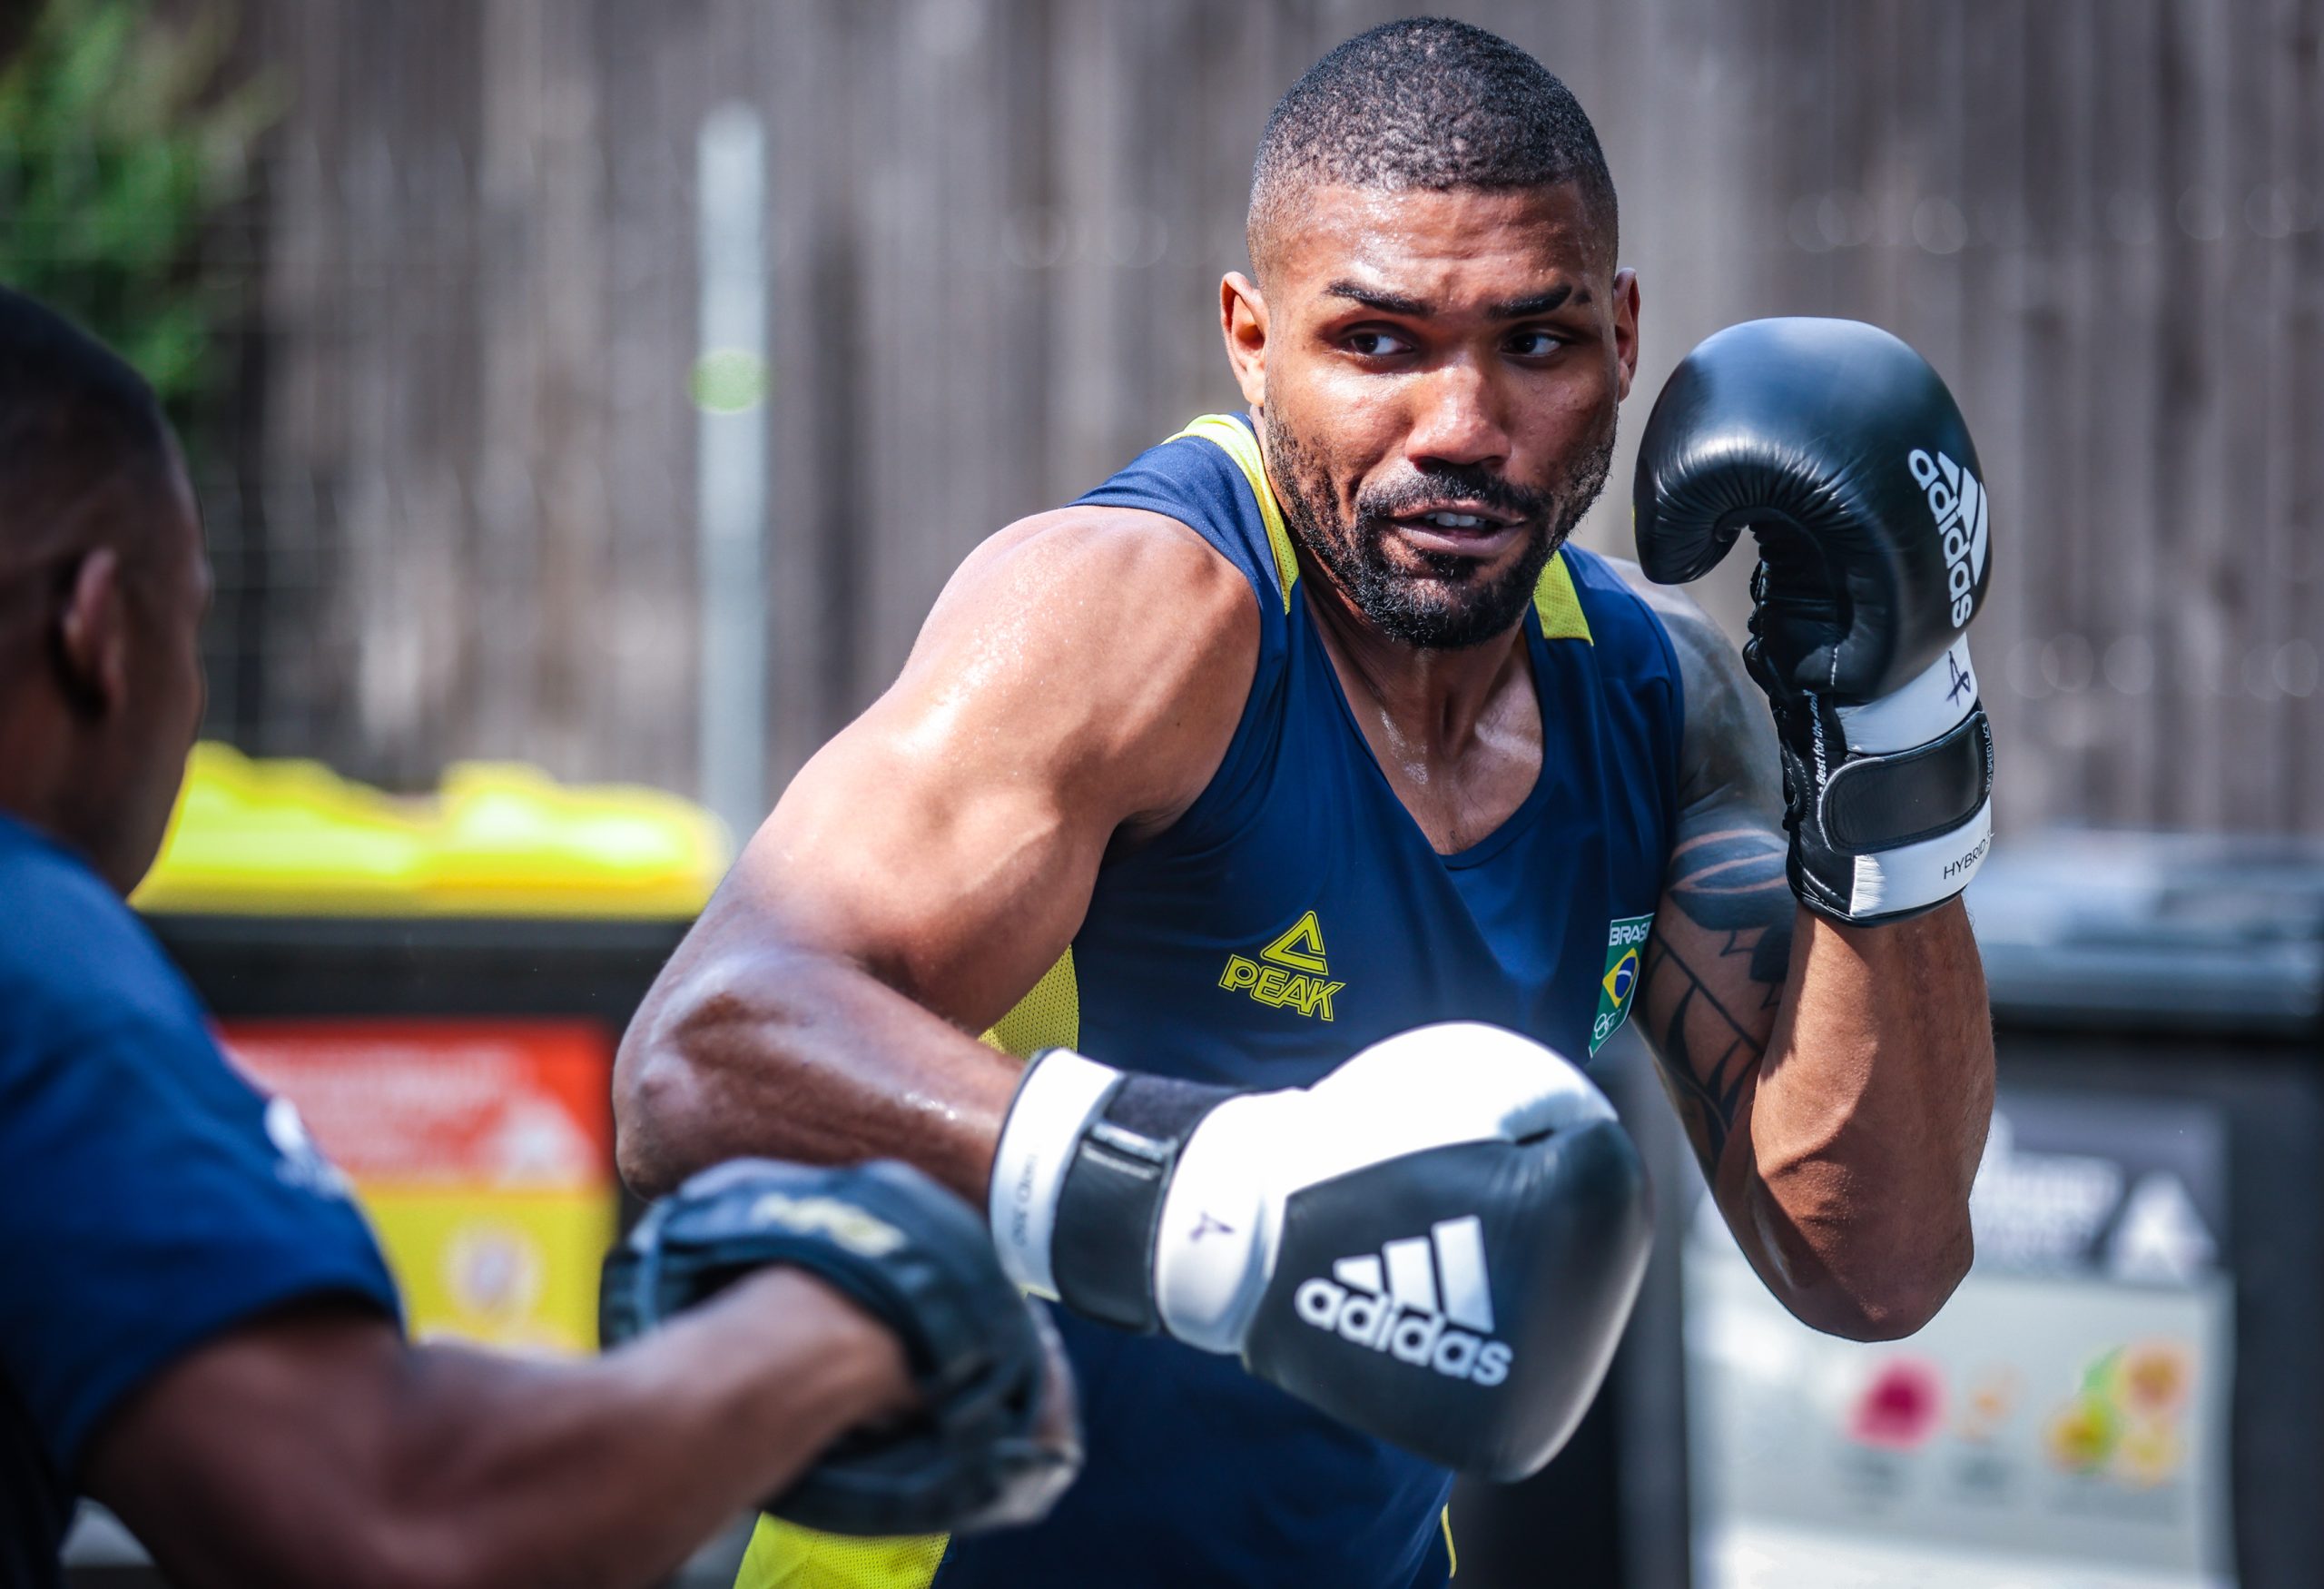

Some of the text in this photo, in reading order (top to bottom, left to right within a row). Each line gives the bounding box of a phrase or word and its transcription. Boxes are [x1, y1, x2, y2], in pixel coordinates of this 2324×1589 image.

[1908, 449, 1973, 628] adidas
[1813, 737, 1826, 757] for
[1983, 721, 1992, 745] LACE
[1815, 756, 1827, 785] Best
[1984, 745, 1994, 773] SPEED
[1944, 838, 1985, 879] HYBRID
[1218, 953, 1346, 1022] PEAK
[1295, 1277, 1513, 1387] adidas
